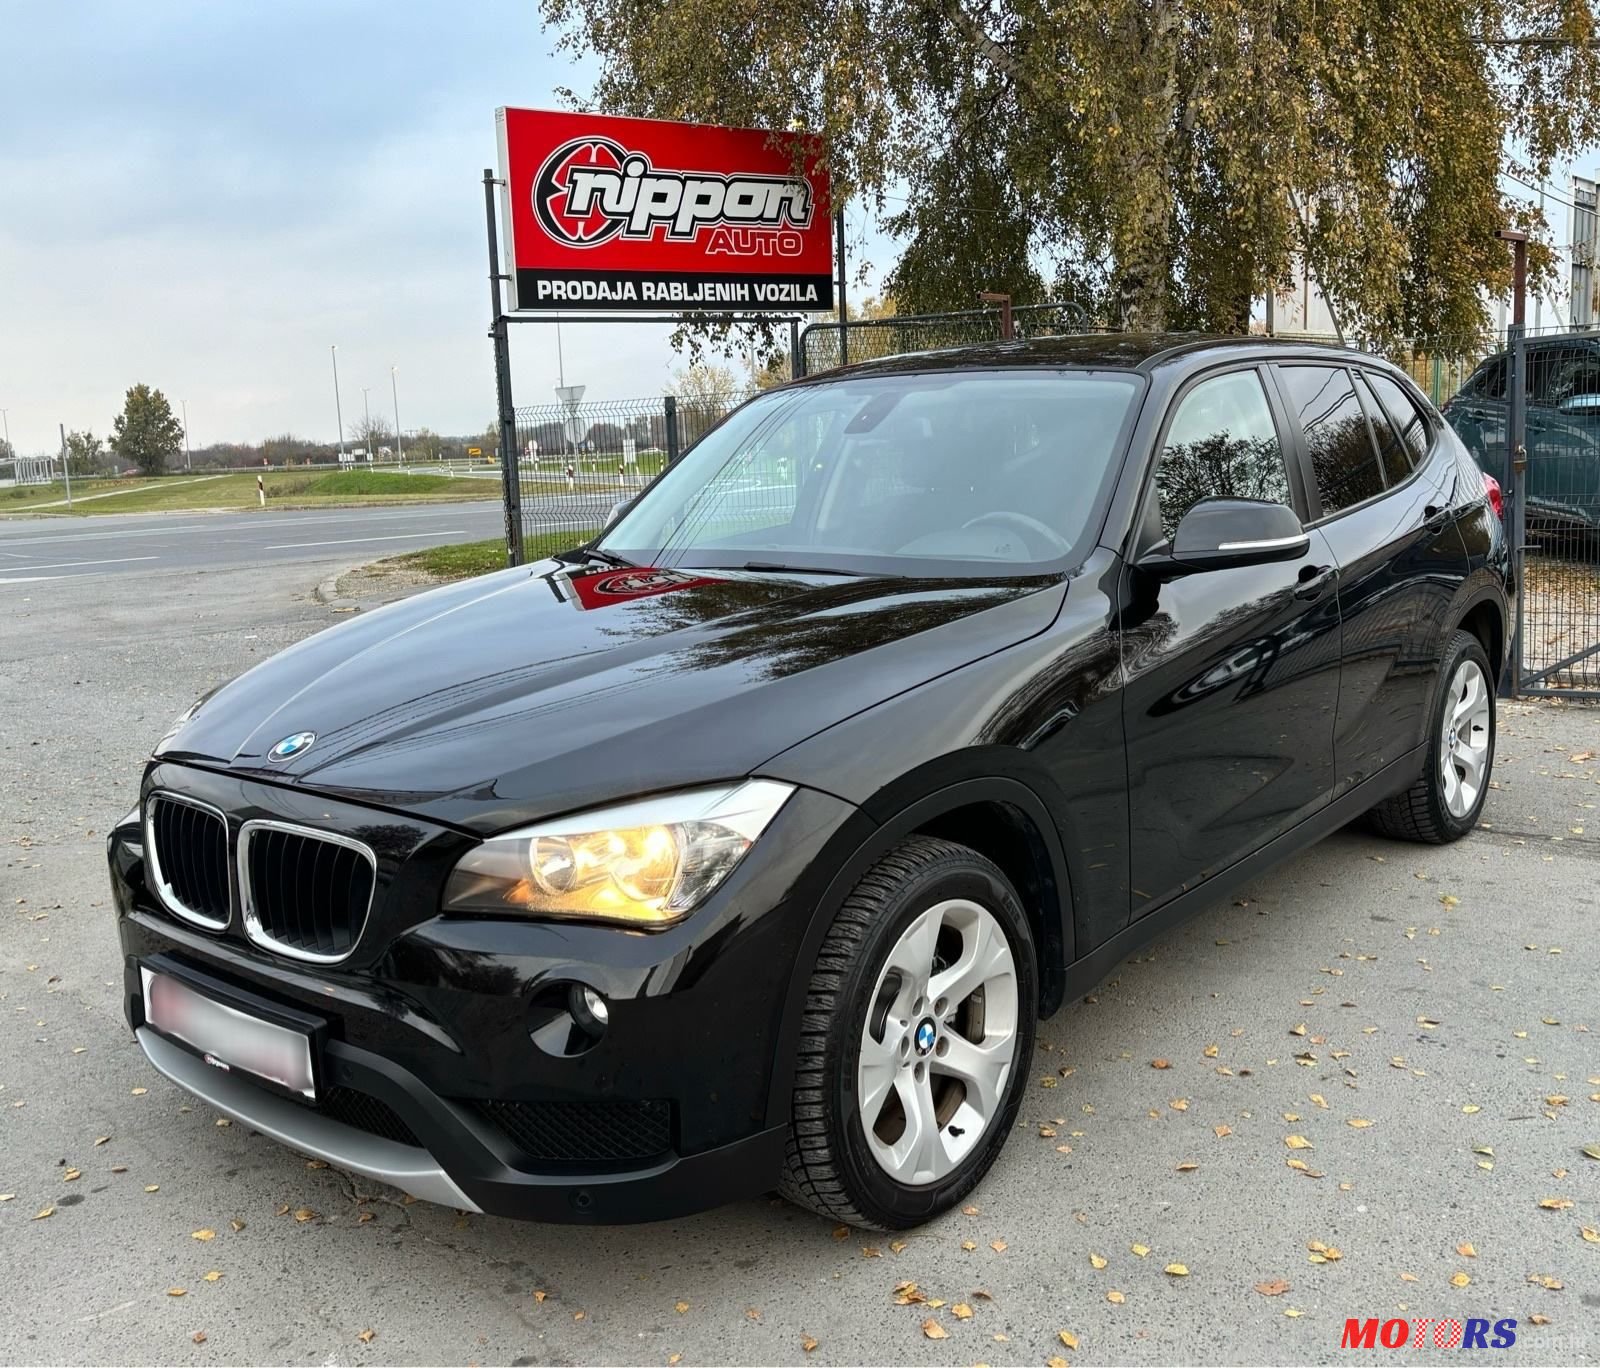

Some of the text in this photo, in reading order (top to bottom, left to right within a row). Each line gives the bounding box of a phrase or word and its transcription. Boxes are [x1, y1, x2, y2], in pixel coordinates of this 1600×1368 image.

[570, 158, 808, 236] nippon
[705, 228, 803, 257] AUTO
[537, 279, 818, 302] PRODAJA RABLJENIH VOZILA
